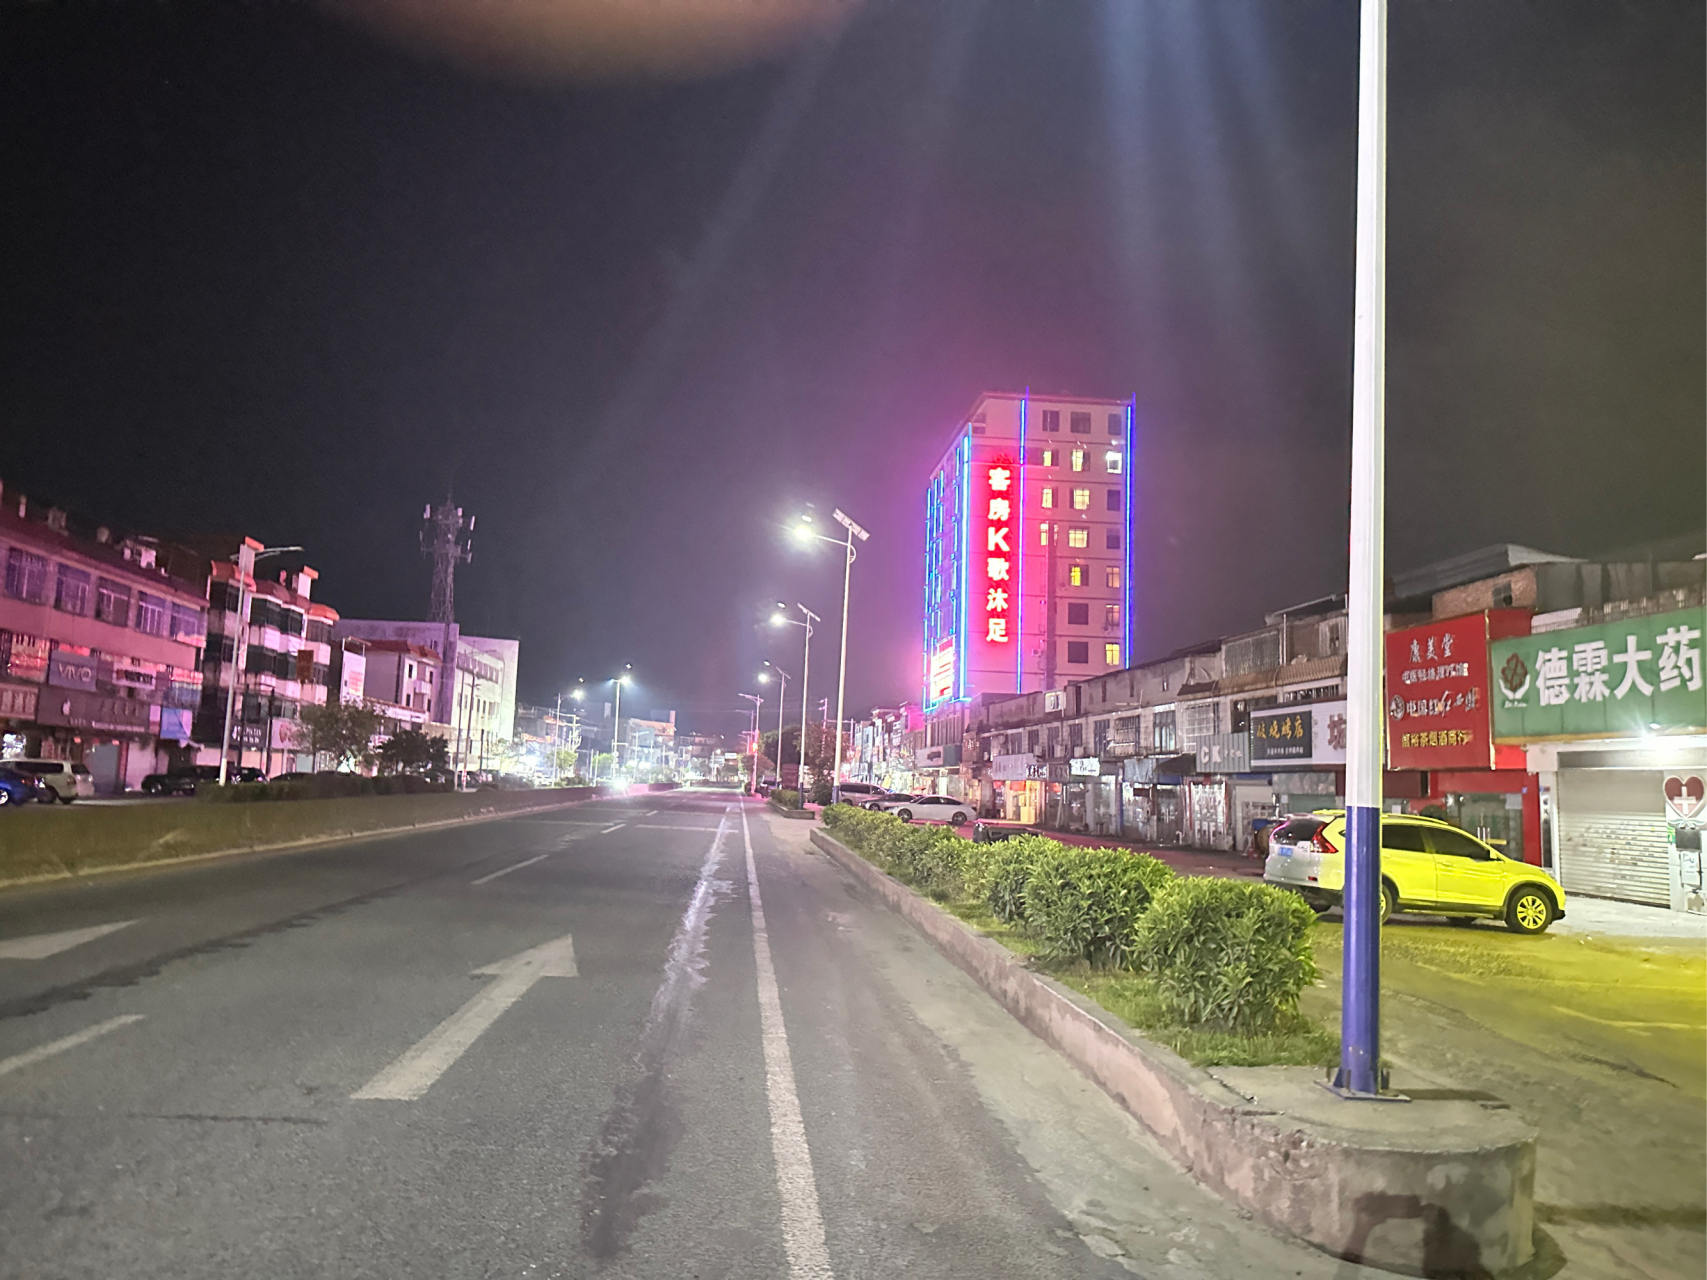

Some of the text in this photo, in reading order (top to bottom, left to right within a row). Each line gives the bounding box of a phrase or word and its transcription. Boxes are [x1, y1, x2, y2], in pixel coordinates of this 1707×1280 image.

[986, 467, 1011, 643] 客房K歌沐足
[1535, 625, 1703, 707] 德霖大药
